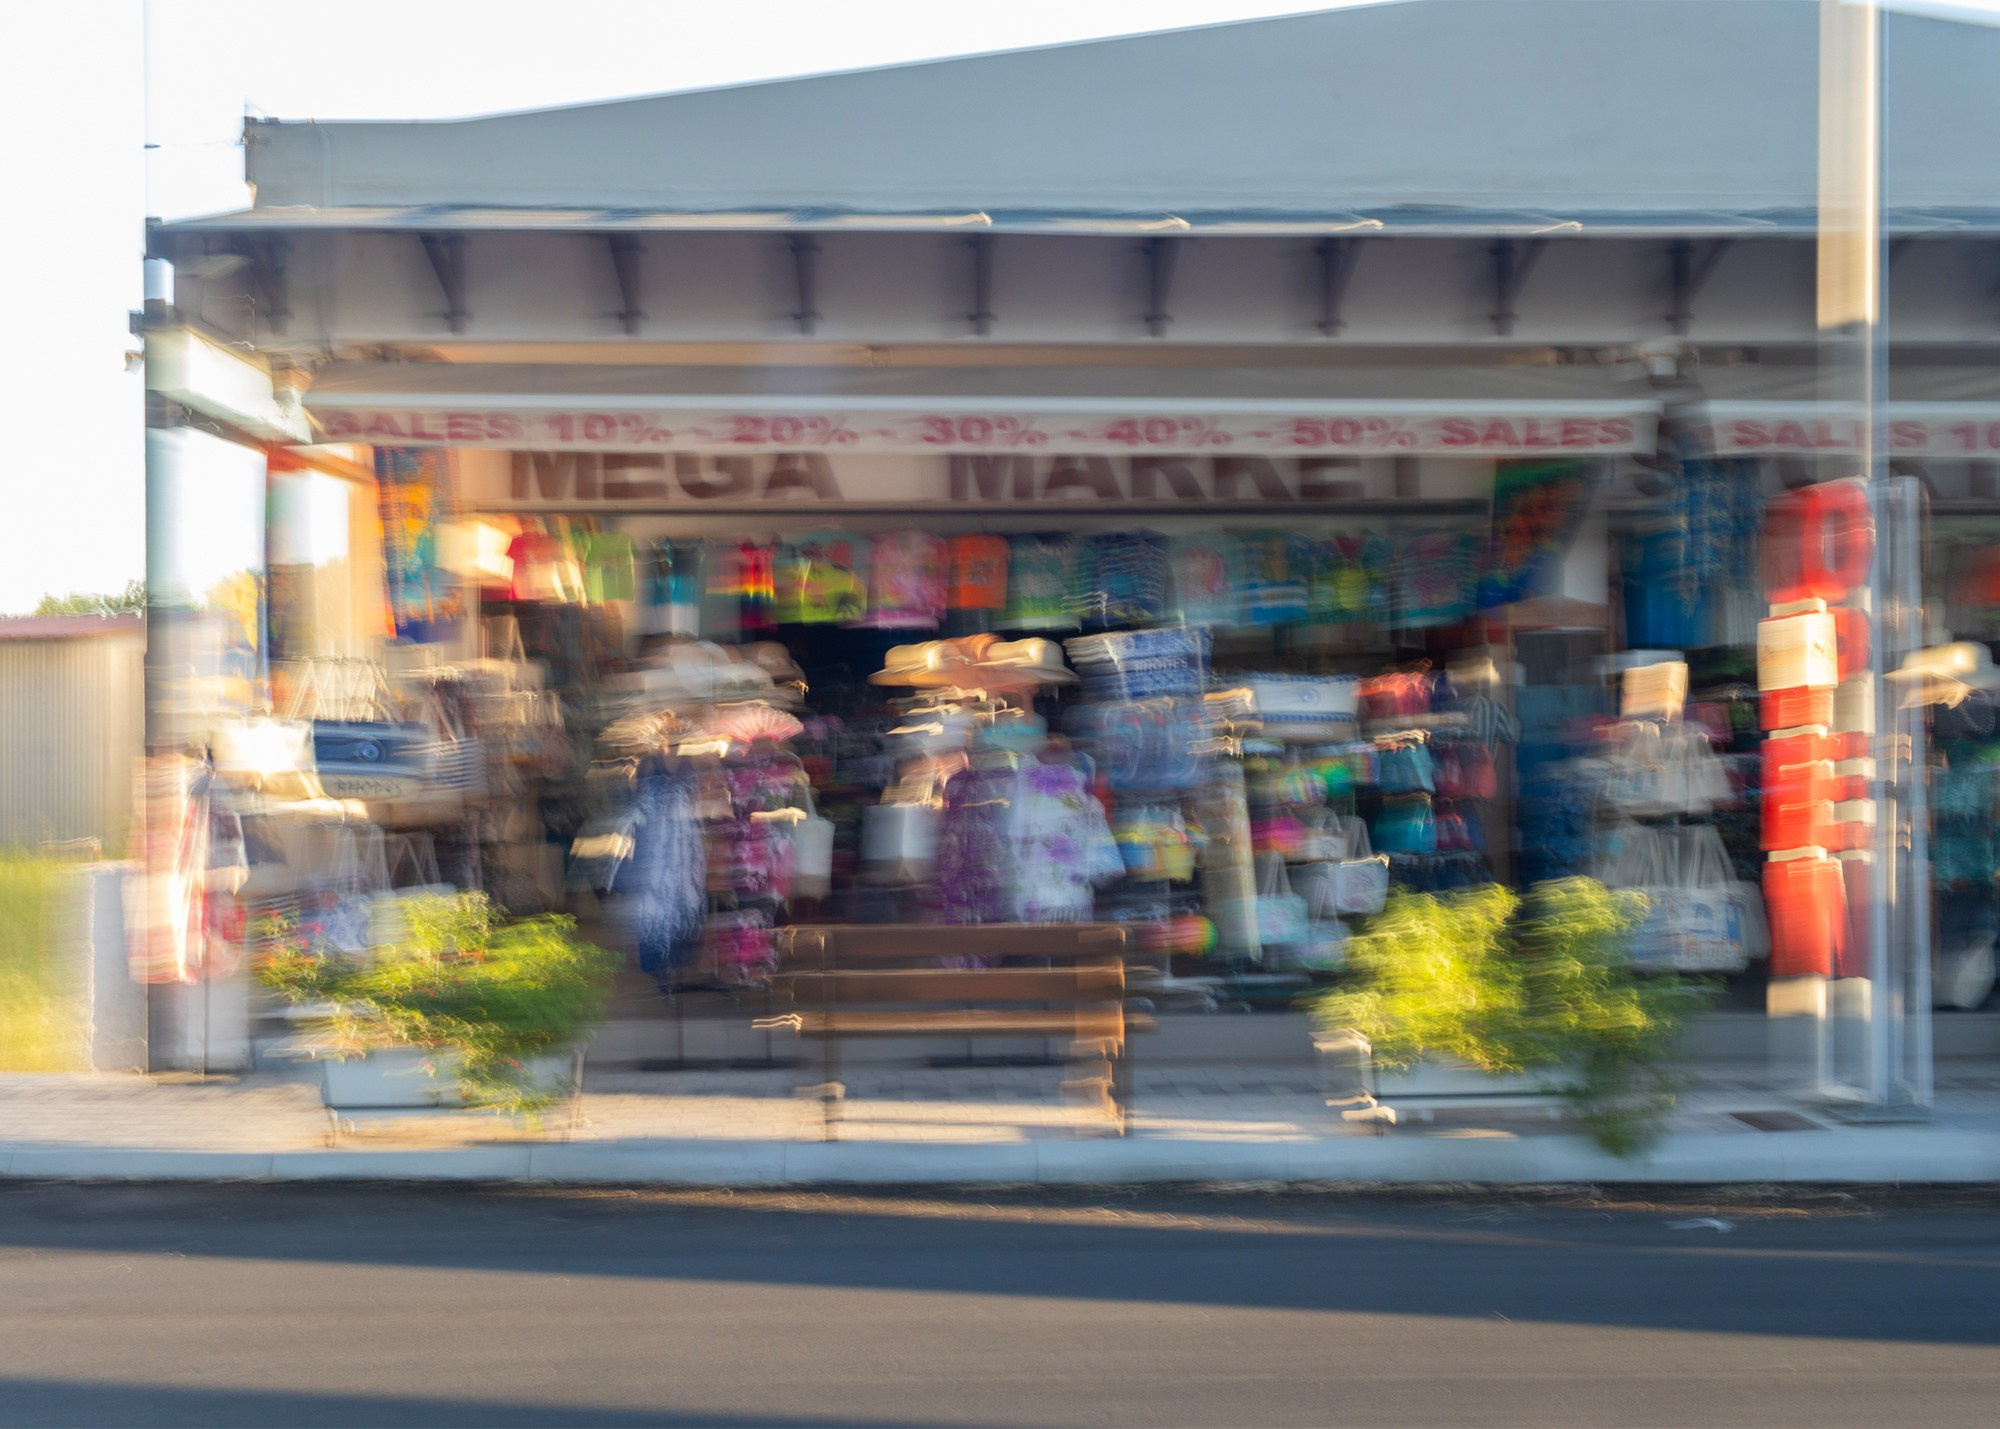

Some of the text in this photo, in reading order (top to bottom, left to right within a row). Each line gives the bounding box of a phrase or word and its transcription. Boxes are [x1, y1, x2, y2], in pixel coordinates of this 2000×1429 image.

[322, 411, 524, 441] SALES
[546, 412, 673, 444] 10%
[730, 415, 861, 445] 20%
[921, 415, 1050, 446] 30%
[1104, 416, 1235, 447] 40%
[1292, 417, 1420, 447] 50%
[1440, 416, 1634, 447] SALES
